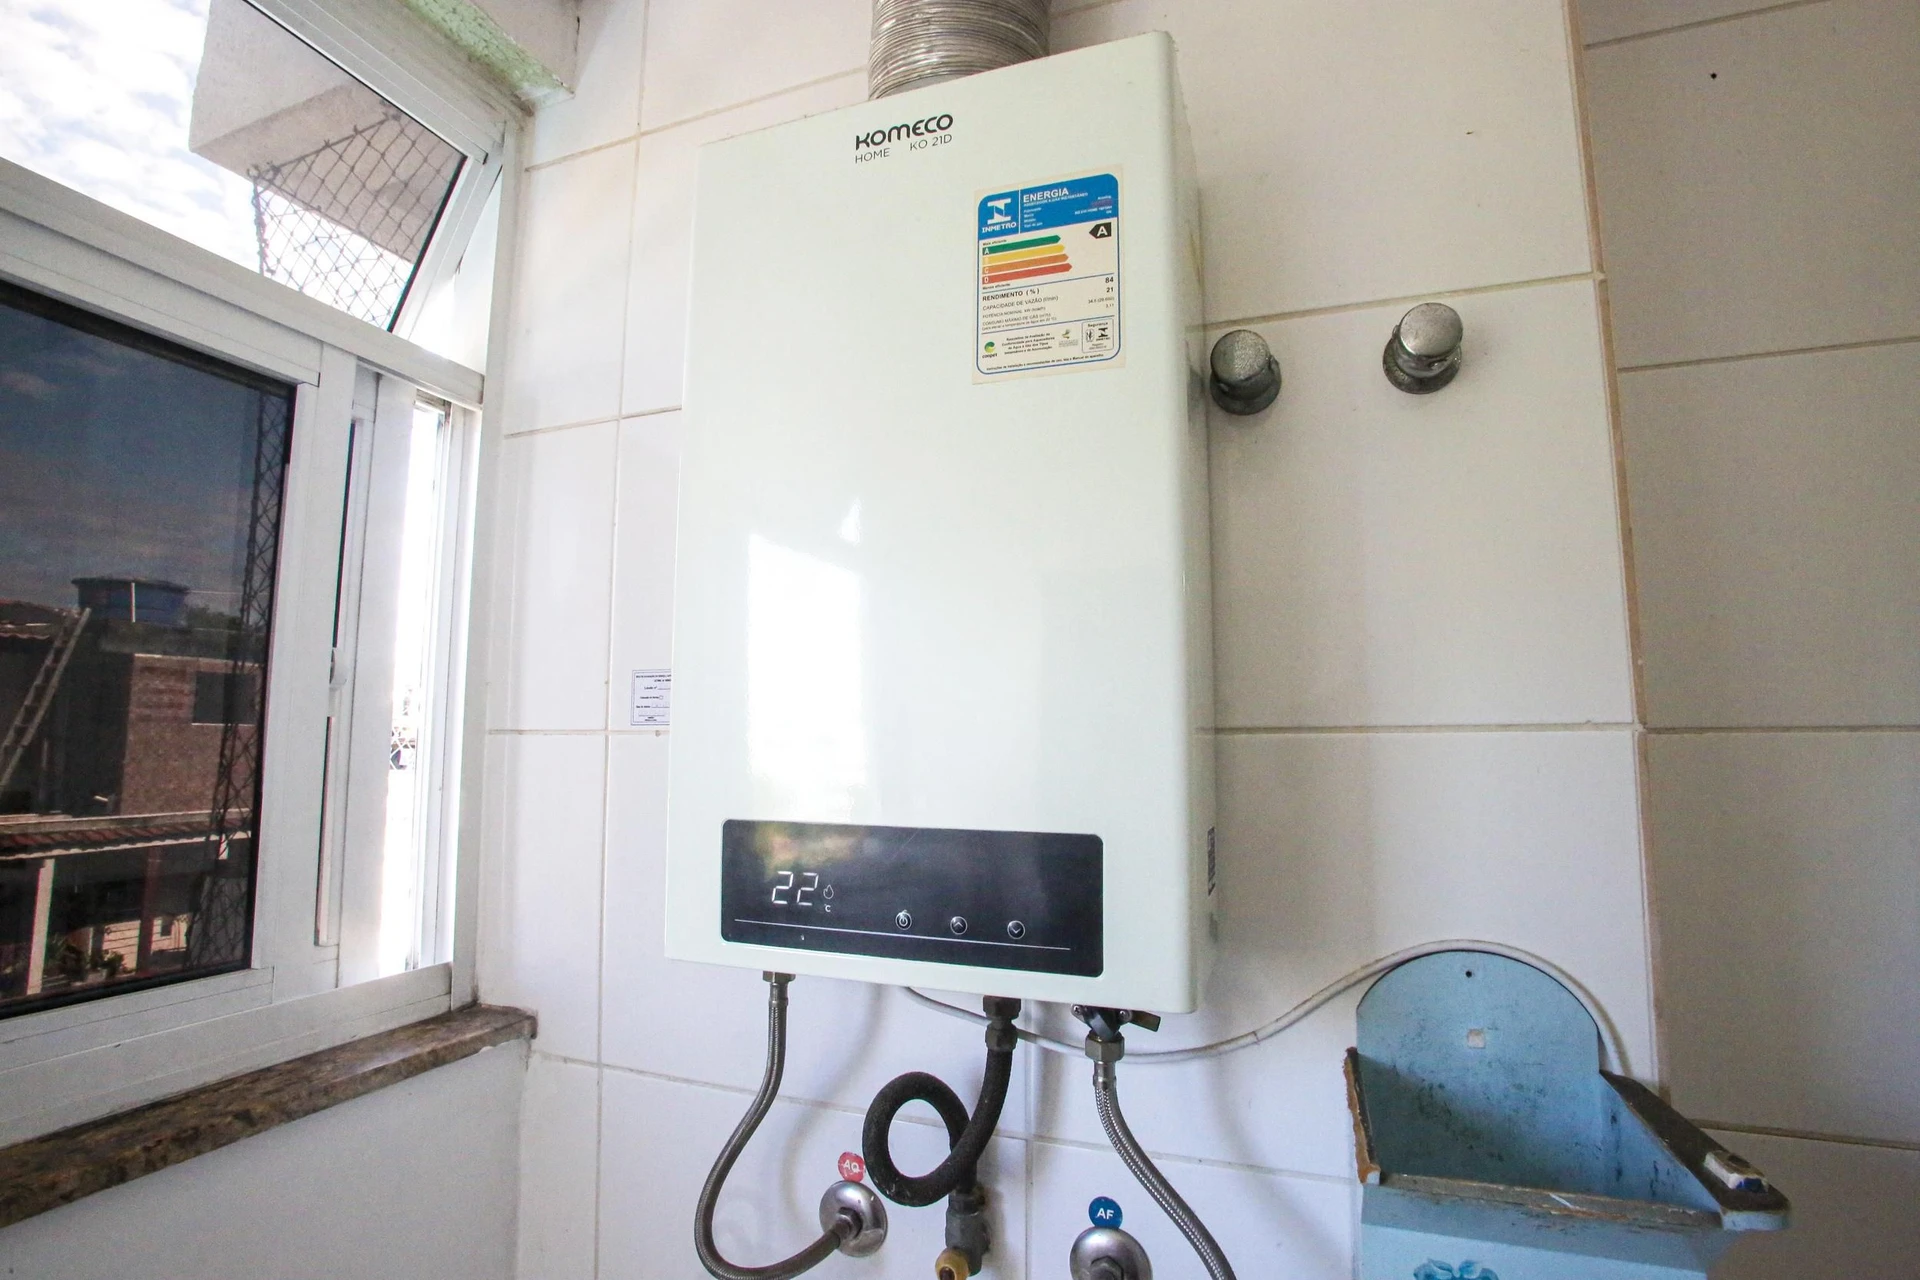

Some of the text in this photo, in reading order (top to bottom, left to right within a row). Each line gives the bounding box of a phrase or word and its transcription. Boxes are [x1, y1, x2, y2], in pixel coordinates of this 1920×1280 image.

[855, 133, 953, 164] HOME KO 21D
[1023, 187, 1069, 203] ENERGIA
[982, 221, 1017, 234] INMETRO
[1097, 225, 1108, 237] A
[984, 247, 990, 255] A
[982, 290, 1023, 302] RENDIMENTO
[982, 301, 1015, 311] CAPACIDADE
[1024, 297, 1042, 305] VAZÃO
[772, 871, 819, 906] 22
[843, 1159, 861, 1173] AQ
[1095, 1207, 1114, 1220] AF
